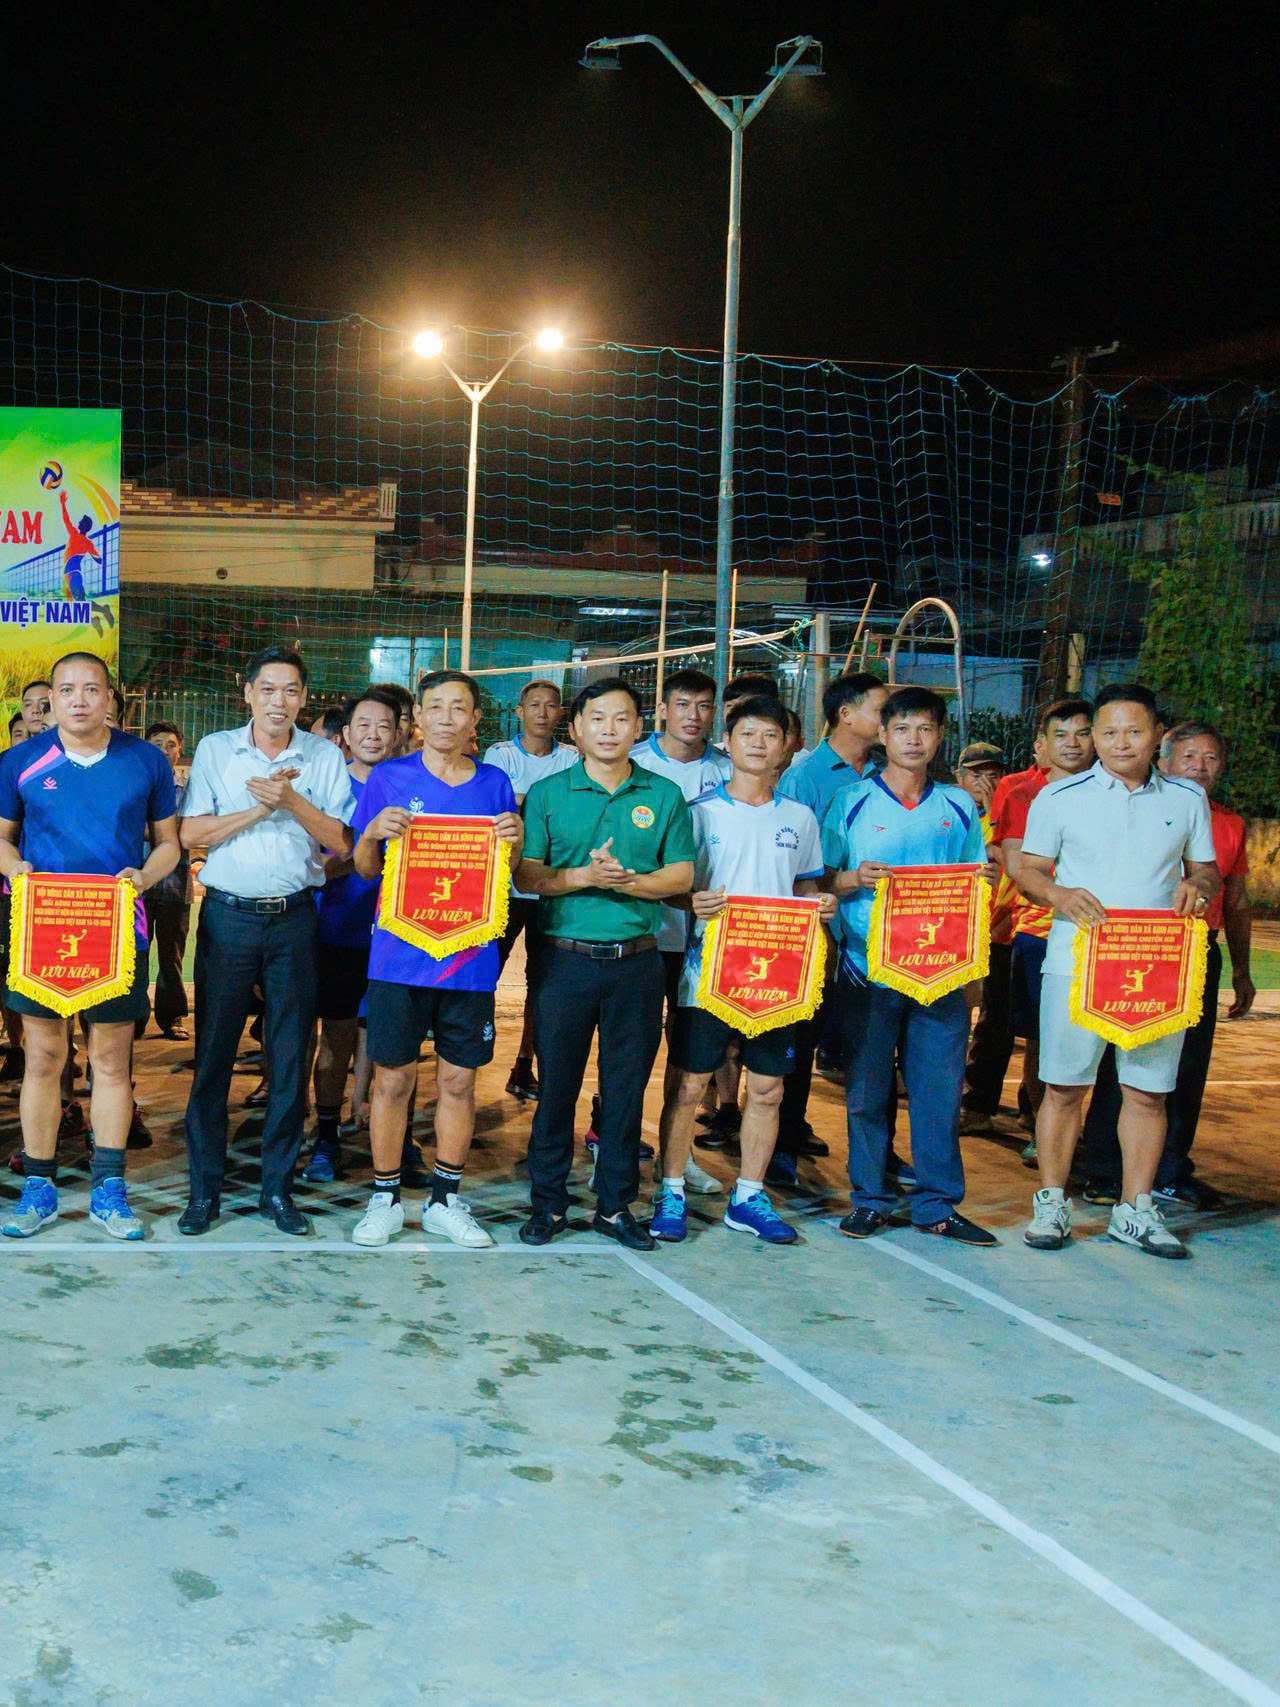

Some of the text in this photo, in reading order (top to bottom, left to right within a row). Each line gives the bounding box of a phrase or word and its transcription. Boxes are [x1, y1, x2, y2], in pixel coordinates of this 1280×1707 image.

[0, 597, 40, 628] VIỆT
[46, 601, 90, 624] NAM
[412, 908, 472, 924] LƯU NIỆM
[898, 951, 957, 968] LƯU NIỆM
[40, 965, 100, 981] LƯU NIỆM
[728, 987, 787, 1005] LƯU NIỆM
[1103, 999, 1166, 1015] LƯU NIỆM
